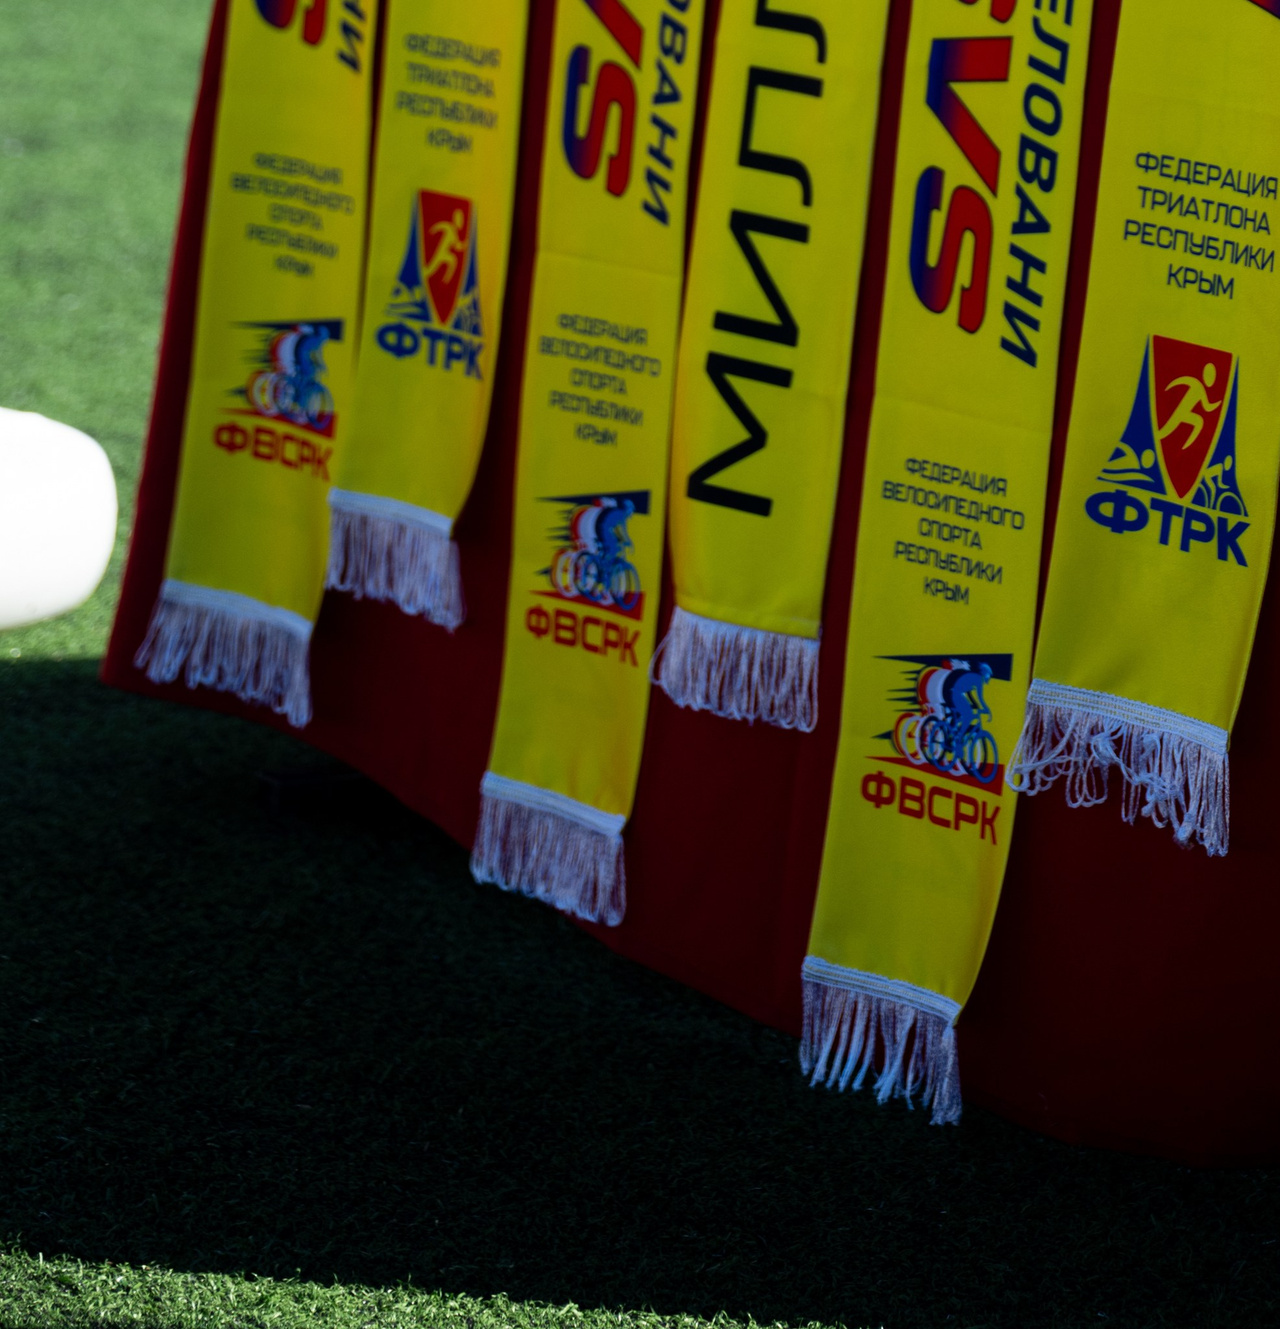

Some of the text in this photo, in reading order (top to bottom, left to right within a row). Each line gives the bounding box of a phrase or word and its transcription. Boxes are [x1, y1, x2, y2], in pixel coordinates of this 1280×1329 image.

[1134, 151, 1278, 200] ФЕДЕРАЦИЯ
[1137, 185, 1271, 235] ТРИАТЛОНА
[1123, 219, 1275, 273] РЕСПУБЛИКИ
[1167, 264, 1234, 299] КРЫМ
[375, 324, 483, 380] ФТРК
[213, 420, 334, 481] ФВСРК
[905, 456, 1007, 498] ФЕДЕРАЦИЯ
[882, 480, 1025, 531] ВЕЛОСИПЕДНОГО
[1084, 489, 1251, 567] ФТРК
[919, 517, 982, 550] СПОРТА
[894, 540, 1003, 585] РЕСПУБЛИКИ
[923, 578, 969, 605] КРЫМ
[525, 604, 640, 666] ФВСРК
[860, 770, 1001, 844] ФВСРК
